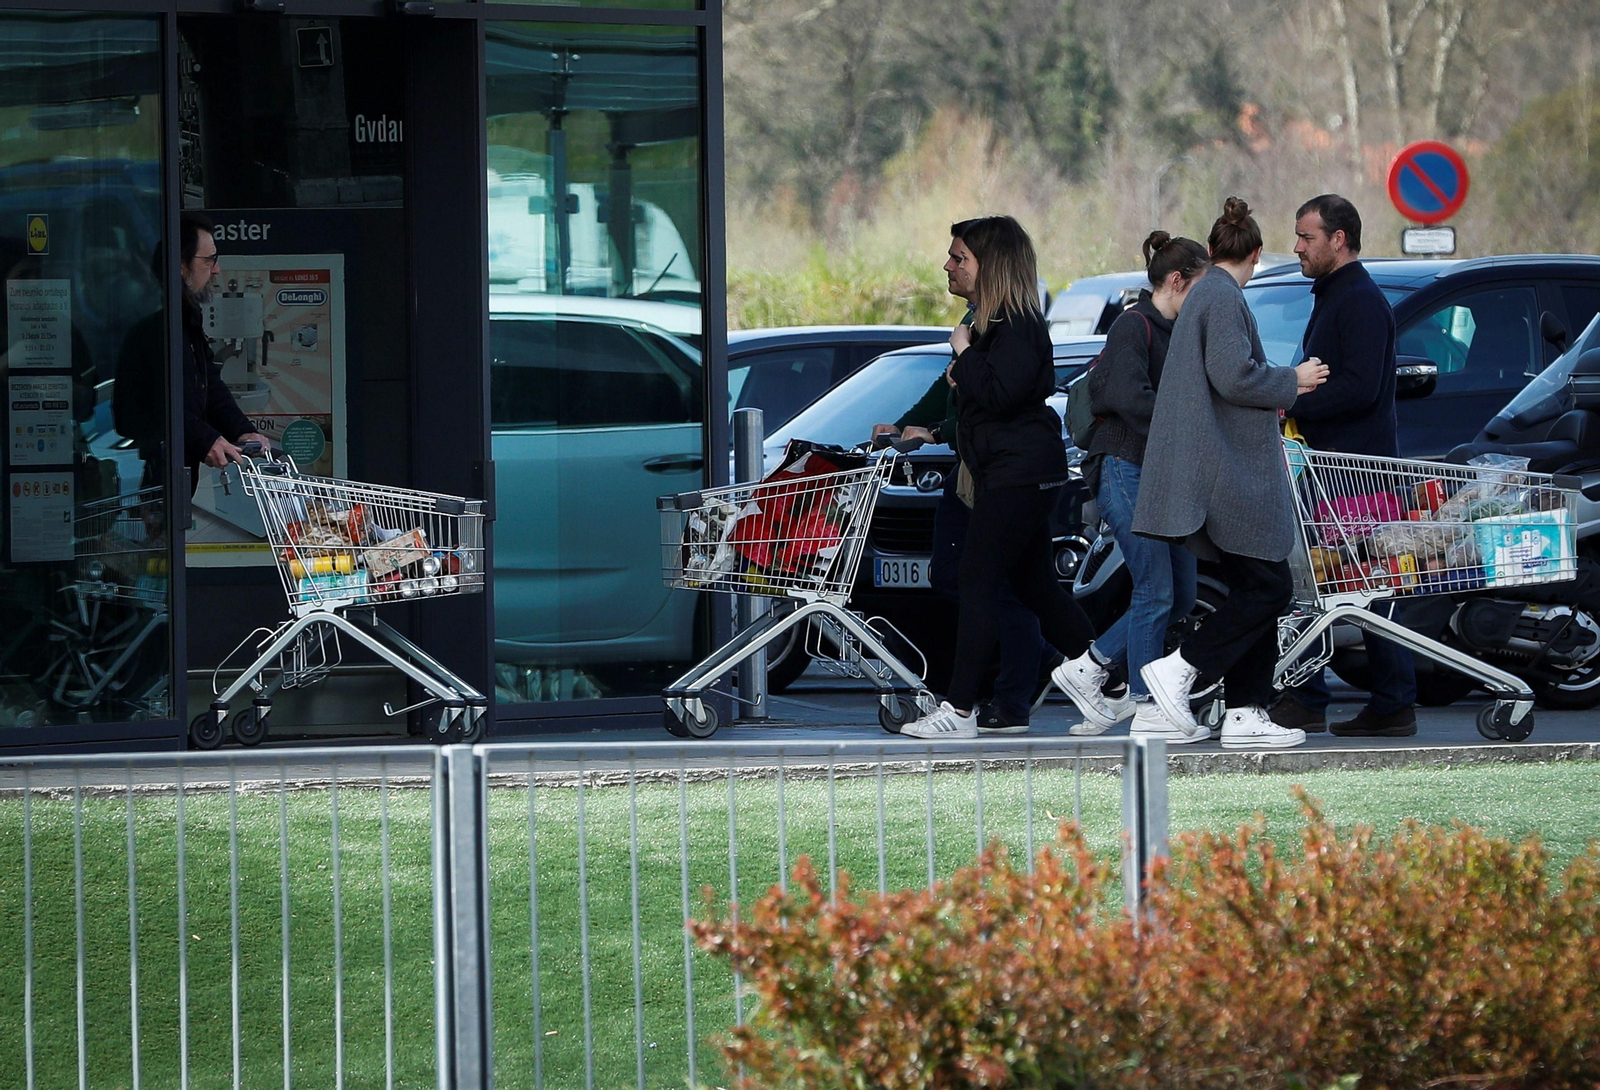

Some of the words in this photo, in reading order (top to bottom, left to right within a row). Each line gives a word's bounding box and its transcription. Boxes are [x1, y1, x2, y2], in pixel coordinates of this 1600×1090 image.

[213, 219, 271, 241] aster
[281, 293, 322, 303] DeLonghi
[883, 561, 919, 584] 0316
